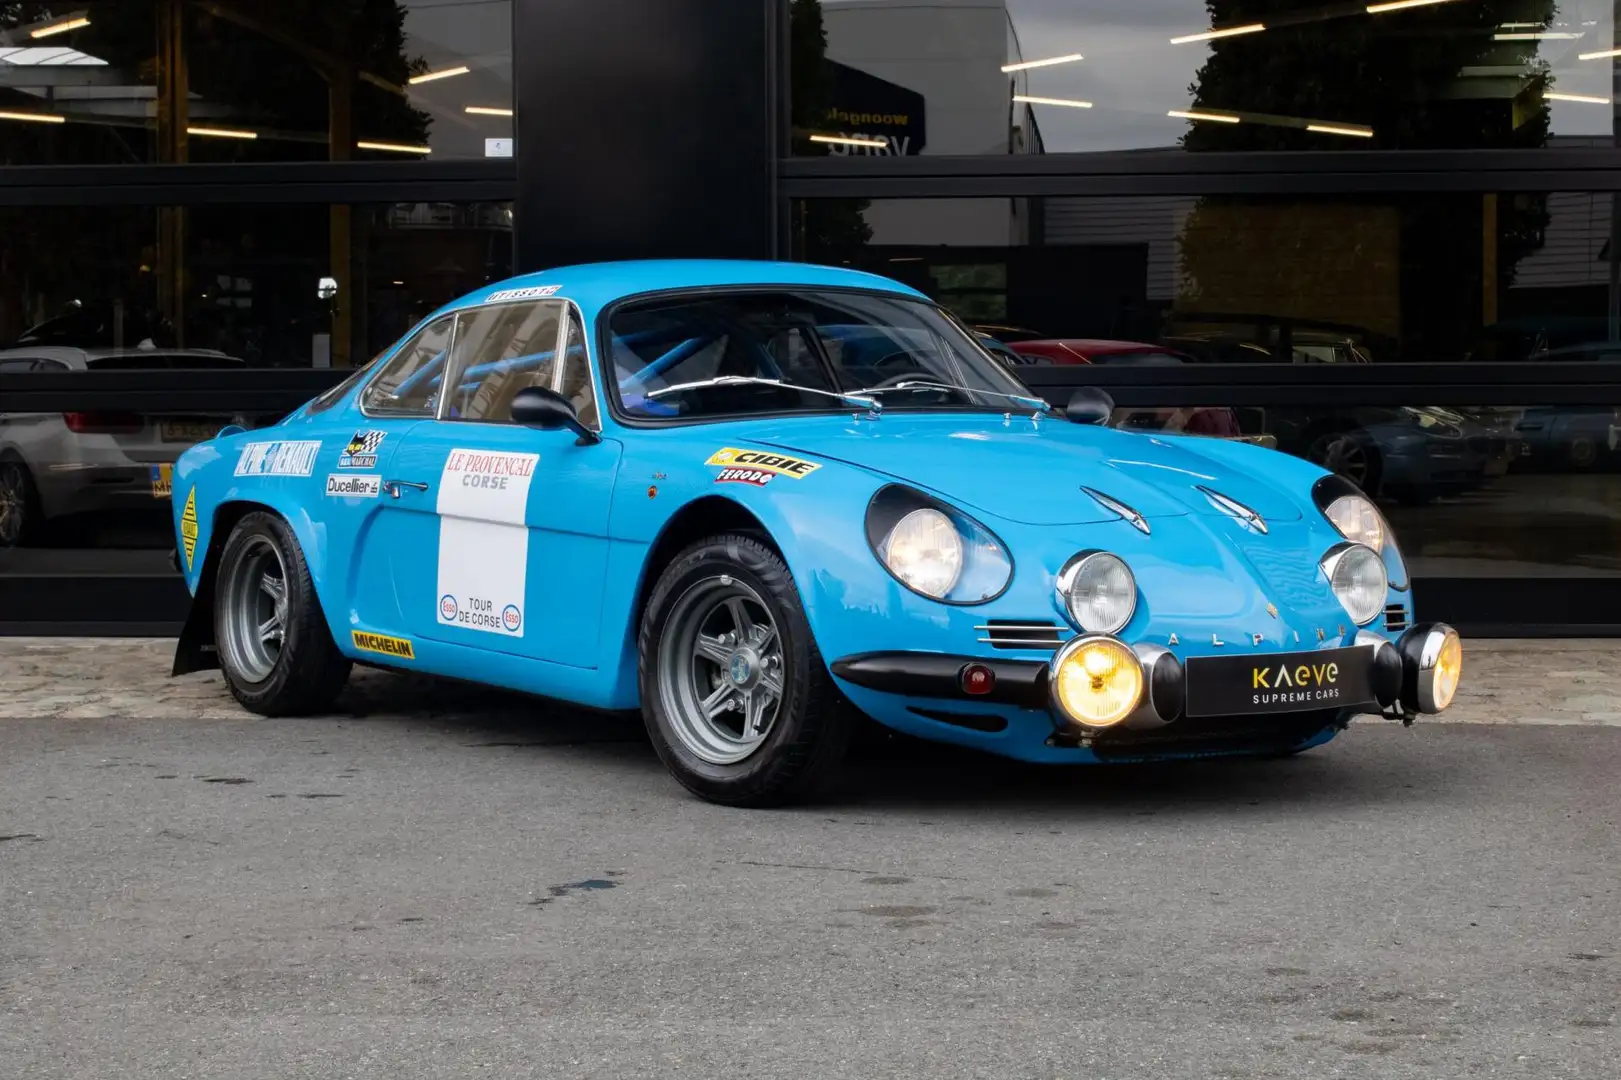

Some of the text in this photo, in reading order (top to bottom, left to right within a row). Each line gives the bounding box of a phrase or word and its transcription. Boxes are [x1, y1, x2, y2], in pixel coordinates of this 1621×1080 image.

[447, 453, 464, 471] LE
[734, 453, 814, 474] CIBIE
[462, 474, 509, 490] CORSE
[717, 469, 773, 483] FERODO
[328, 477, 370, 493] Ducellier
[469, 597, 493, 612] TOUR
[459, 611, 501, 628] DE CORSE
[1168, 624, 1346, 647] ALPINE
[354, 633, 412, 657] MICHELIN
[1253, 688, 1340, 704] SUPREME CARS
